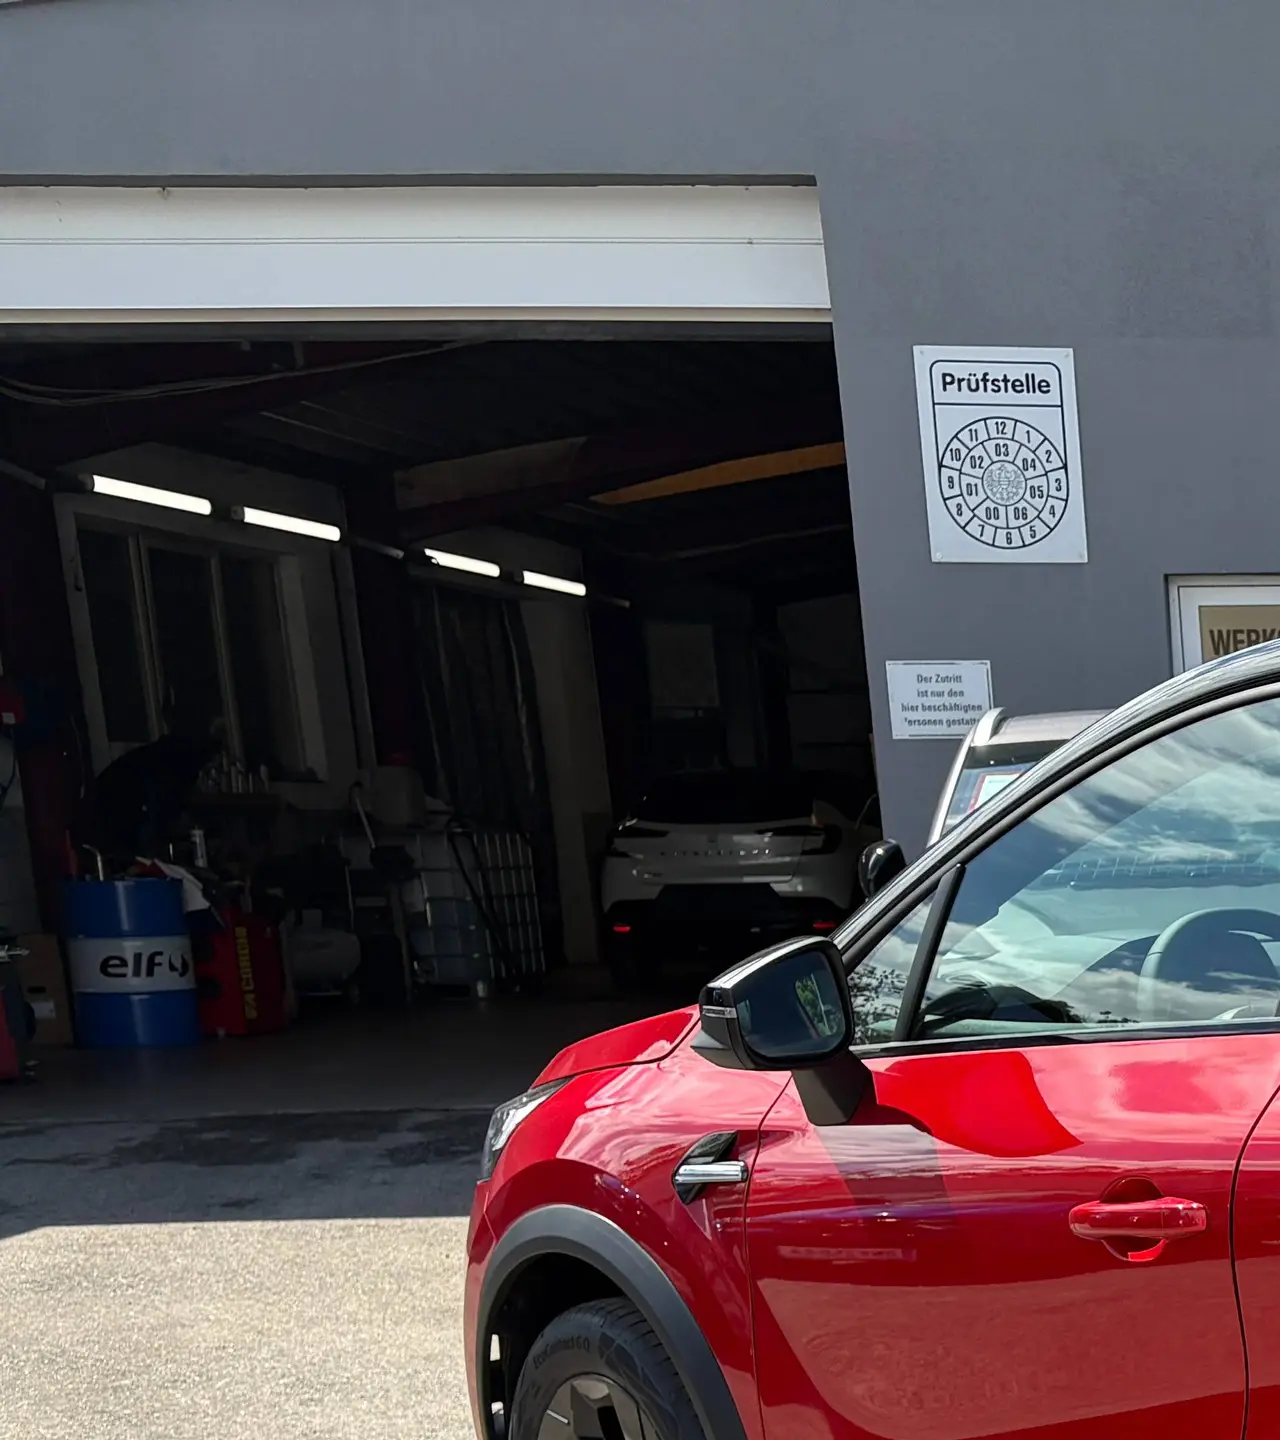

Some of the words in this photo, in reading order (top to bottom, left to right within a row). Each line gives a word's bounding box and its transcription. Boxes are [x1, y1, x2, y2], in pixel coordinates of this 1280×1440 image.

[941, 372, 1051, 395] Prüfstelle
[968, 428, 979, 442] 11
[994, 421, 1007, 436] 12
[1025, 430, 1031, 444] 1
[949, 448, 962, 462] 10
[994, 443, 1010, 457] 03
[1045, 450, 1053, 464] 2
[969, 455, 985, 469] 02
[1022, 457, 1036, 472] 04
[947, 475, 954, 489] 9
[1055, 478, 1062, 492] 3
[966, 483, 979, 497] 01
[1029, 485, 1044, 499] 05
[956, 503, 963, 517] 8
[985, 506, 1000, 520] 00
[1013, 506, 1028, 521] 06
[1049, 504, 1056, 517] 4
[978, 524, 985, 538] 7
[1005, 531, 1013, 545] 6
[1029, 525, 1037, 539] 5
[916, 674, 932, 684] Der
[934, 674, 962, 684] Zutritt
[917, 689, 928, 698] ist
[930, 690, 945, 698] nur
[947, 688, 964, 698] den
[901, 703, 919, 713] hier
[921, 702, 982, 714] beschäftigten
[99, 950, 164, 978] elf
